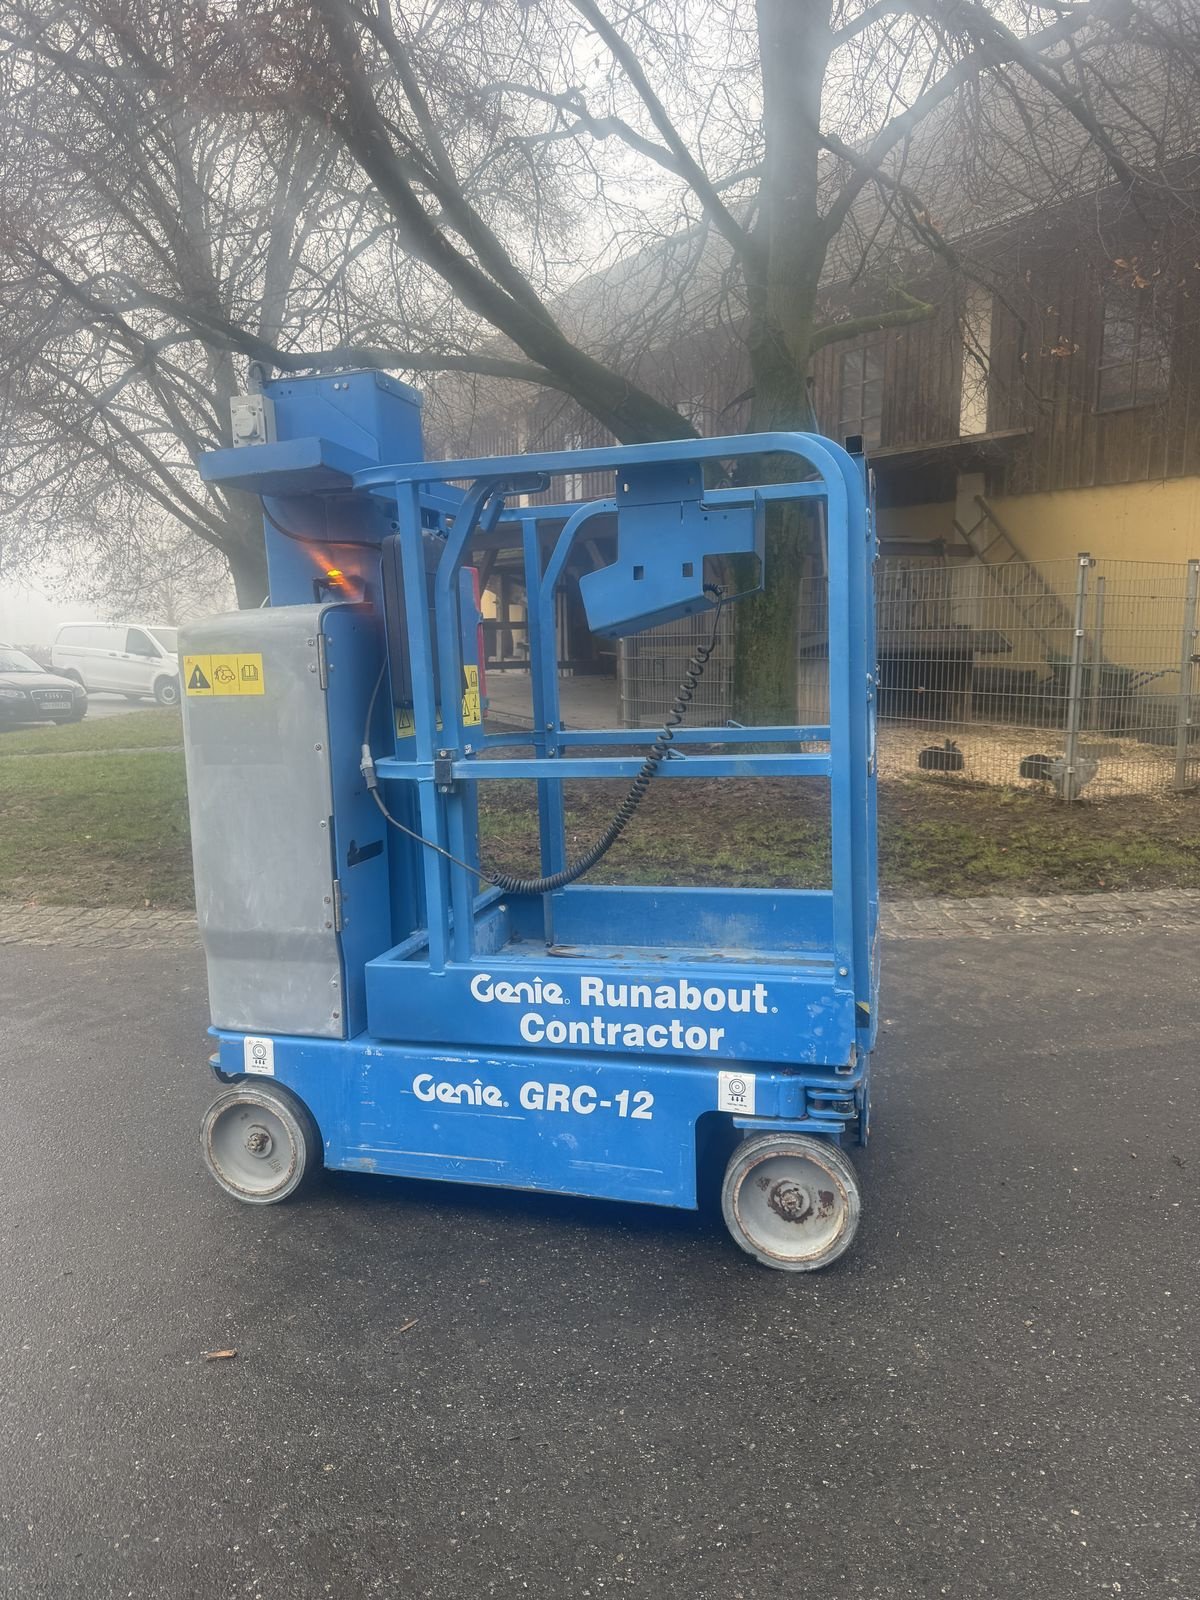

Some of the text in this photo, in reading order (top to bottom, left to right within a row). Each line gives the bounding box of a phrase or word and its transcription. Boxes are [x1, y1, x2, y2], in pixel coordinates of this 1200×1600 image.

[470, 973, 768, 1014] Genie Runabout
[519, 1012, 725, 1051] Contractor
[412, 1073, 655, 1120] Genie GRC-12
